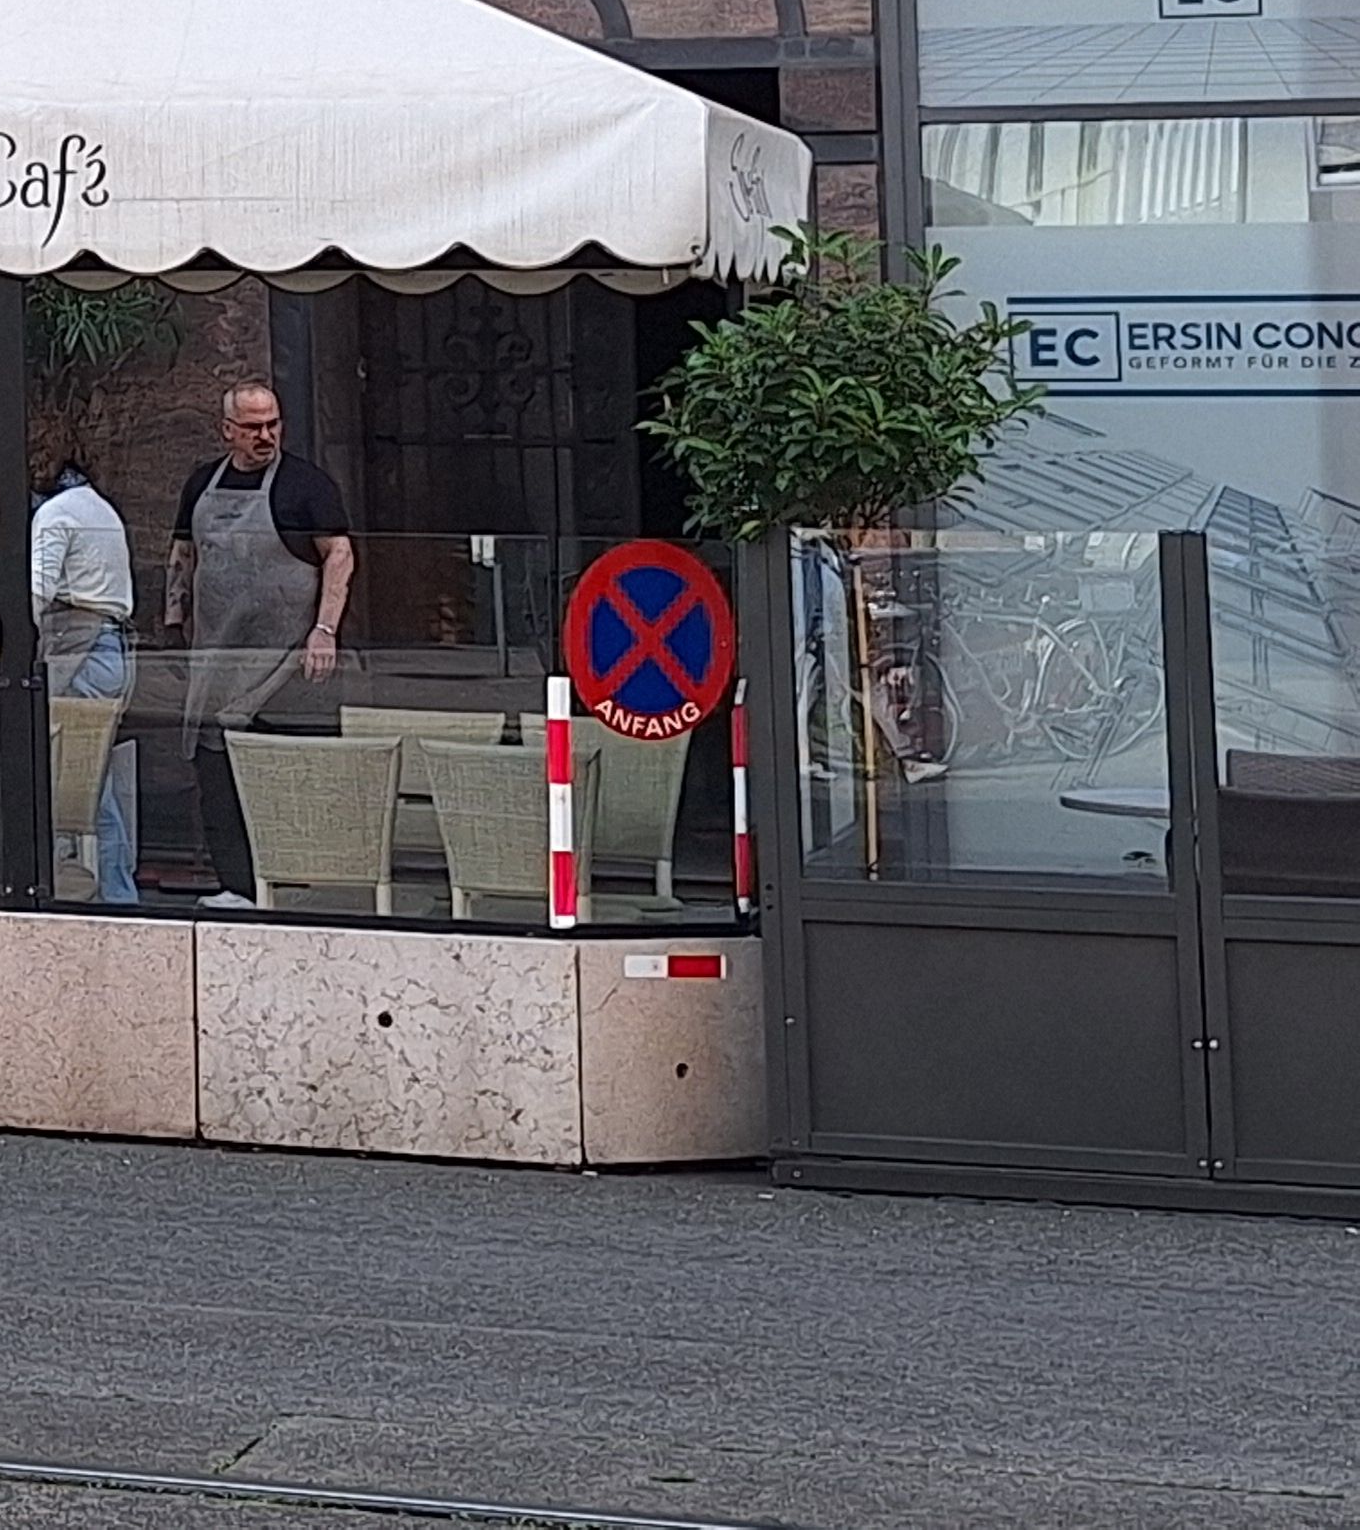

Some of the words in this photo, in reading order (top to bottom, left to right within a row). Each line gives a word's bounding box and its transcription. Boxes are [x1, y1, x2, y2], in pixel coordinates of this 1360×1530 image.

[1030, 327, 1101, 368] EC
[1128, 321, 1242, 351] ERSIN
[1128, 356, 1236, 370] GEFORMT
[1247, 353, 1290, 370] FÜR
[1300, 355, 1338, 370] DIE
[594, 699, 702, 738] ANFANG
